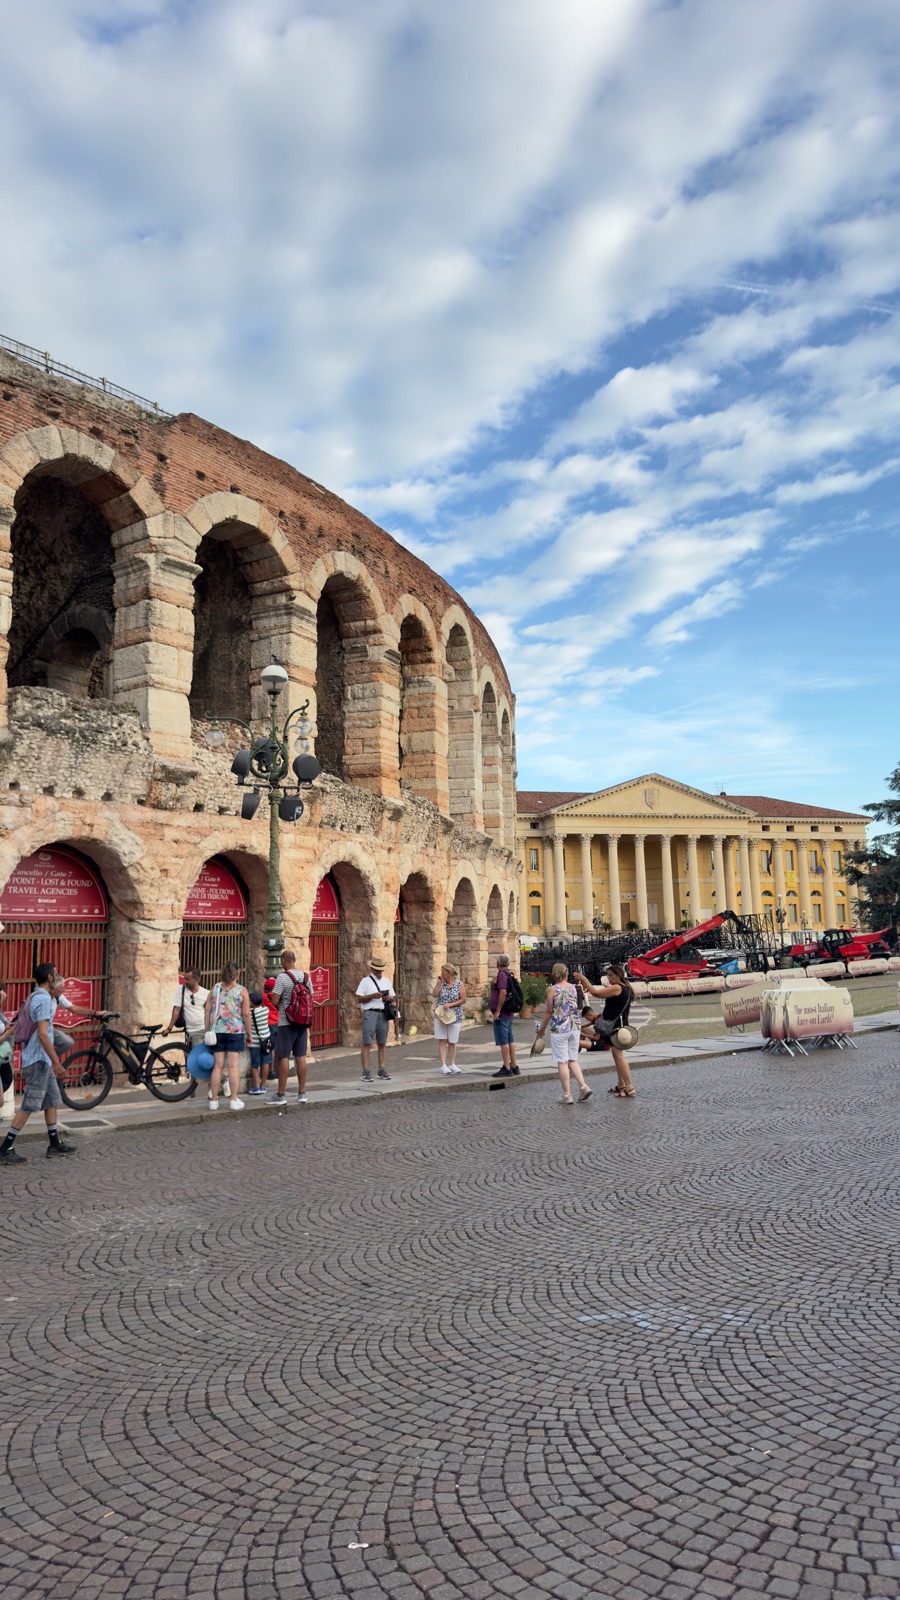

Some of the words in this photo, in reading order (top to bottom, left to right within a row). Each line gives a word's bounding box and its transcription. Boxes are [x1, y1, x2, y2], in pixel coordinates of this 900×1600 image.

[12, 877, 36, 885] POINT
[67, 879, 93, 887] FOUND
[8, 886, 39, 894] TRAVEL
[40, 887, 78, 896] AGENCIES
[803, 1006, 817, 1014] most
[817, 1003, 834, 1013] Italian
[809, 1017, 816, 1025] on
